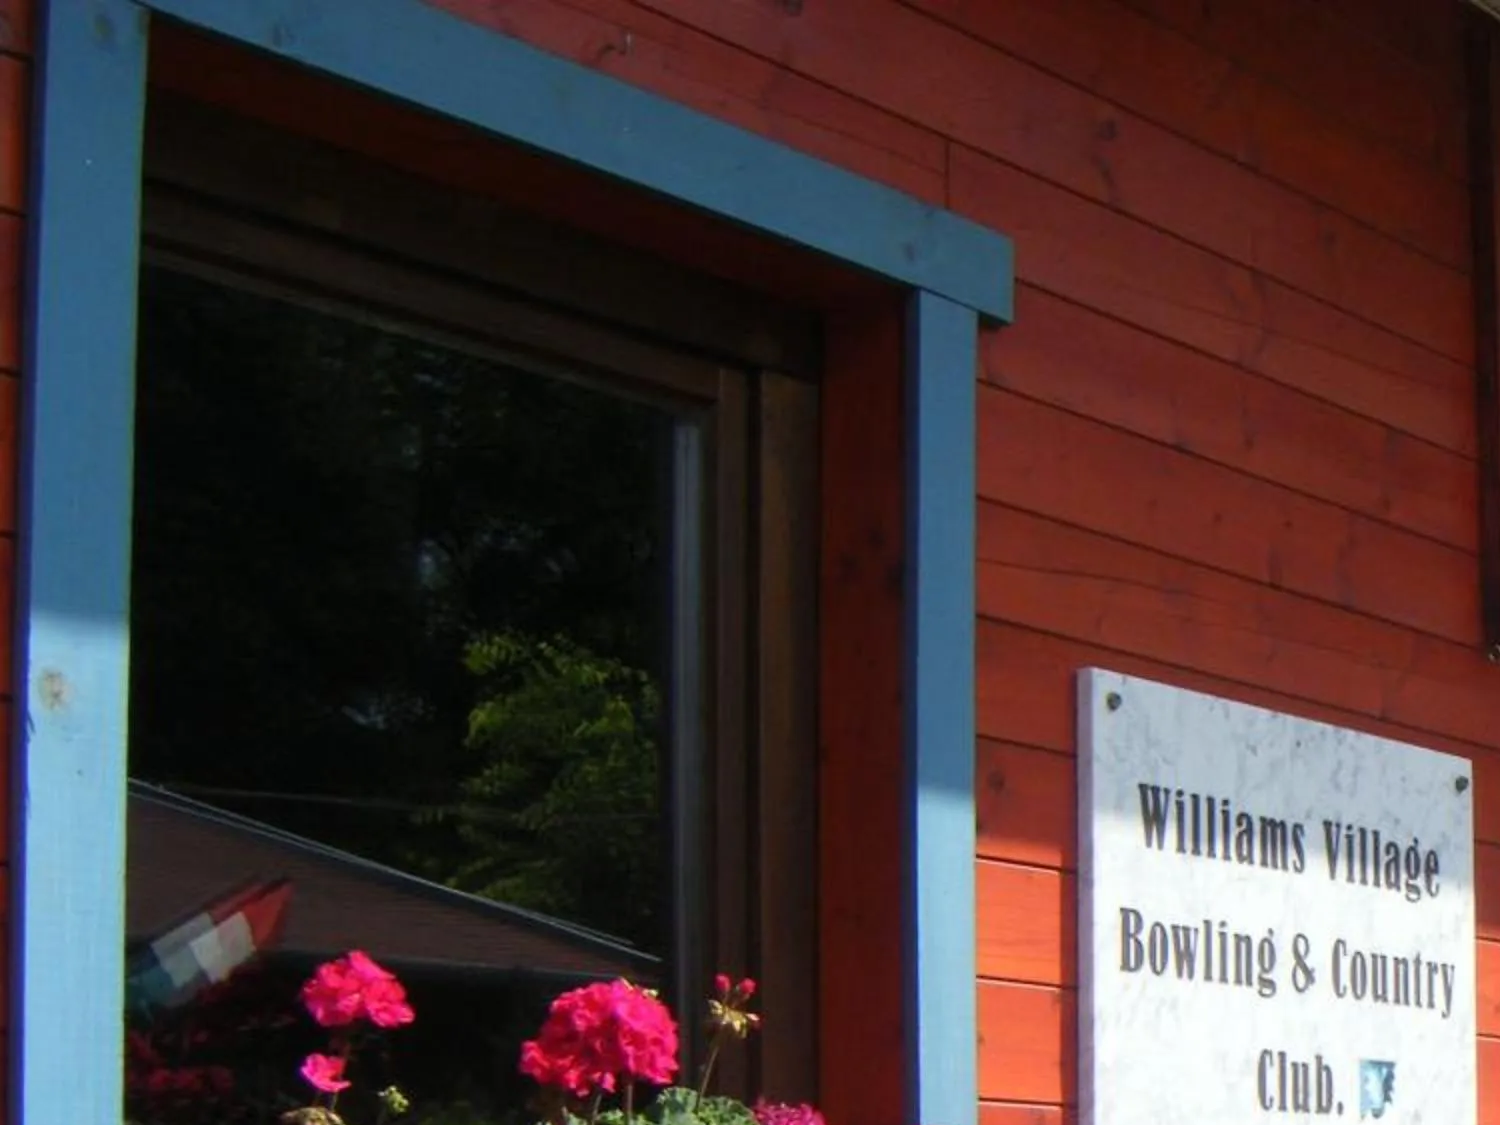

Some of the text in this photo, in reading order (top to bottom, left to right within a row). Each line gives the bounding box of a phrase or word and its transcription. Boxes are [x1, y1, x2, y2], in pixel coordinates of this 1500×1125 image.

[1138, 782, 1442, 902] Williams Village
[1119, 907, 1456, 1018] Bowling & Country
[1256, 1048, 1345, 1116] Club.
